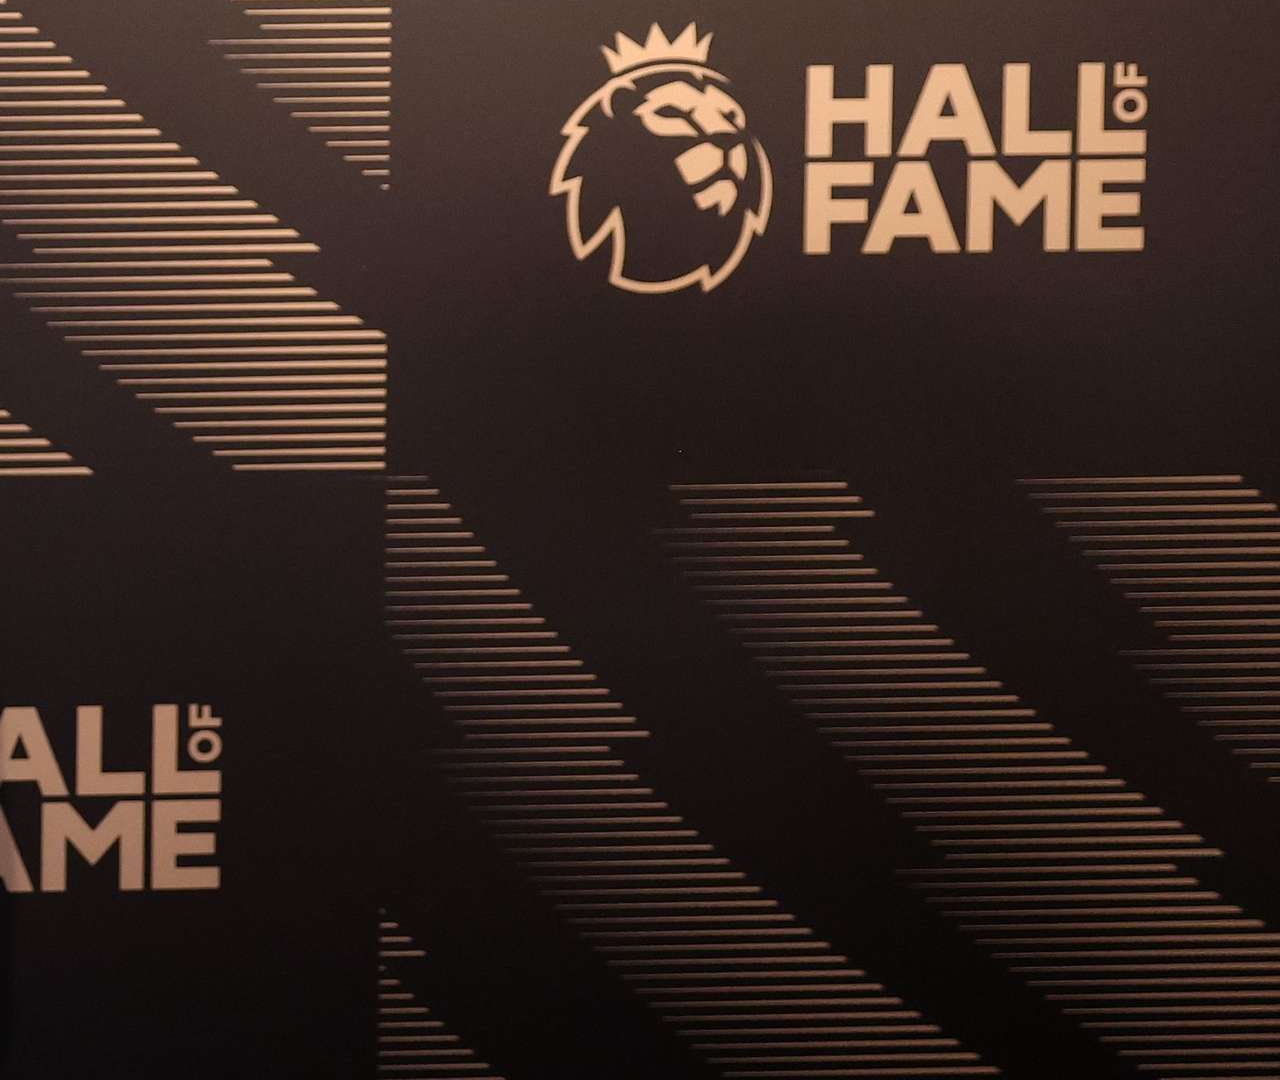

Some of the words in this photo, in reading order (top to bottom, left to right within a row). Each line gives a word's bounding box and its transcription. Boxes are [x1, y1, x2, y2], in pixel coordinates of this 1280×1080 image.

[805, 62, 1147, 158] HALL
[1112, 61, 1149, 123] OF
[803, 158, 1146, 255] FAME
[187, 703, 223, 763] OF
